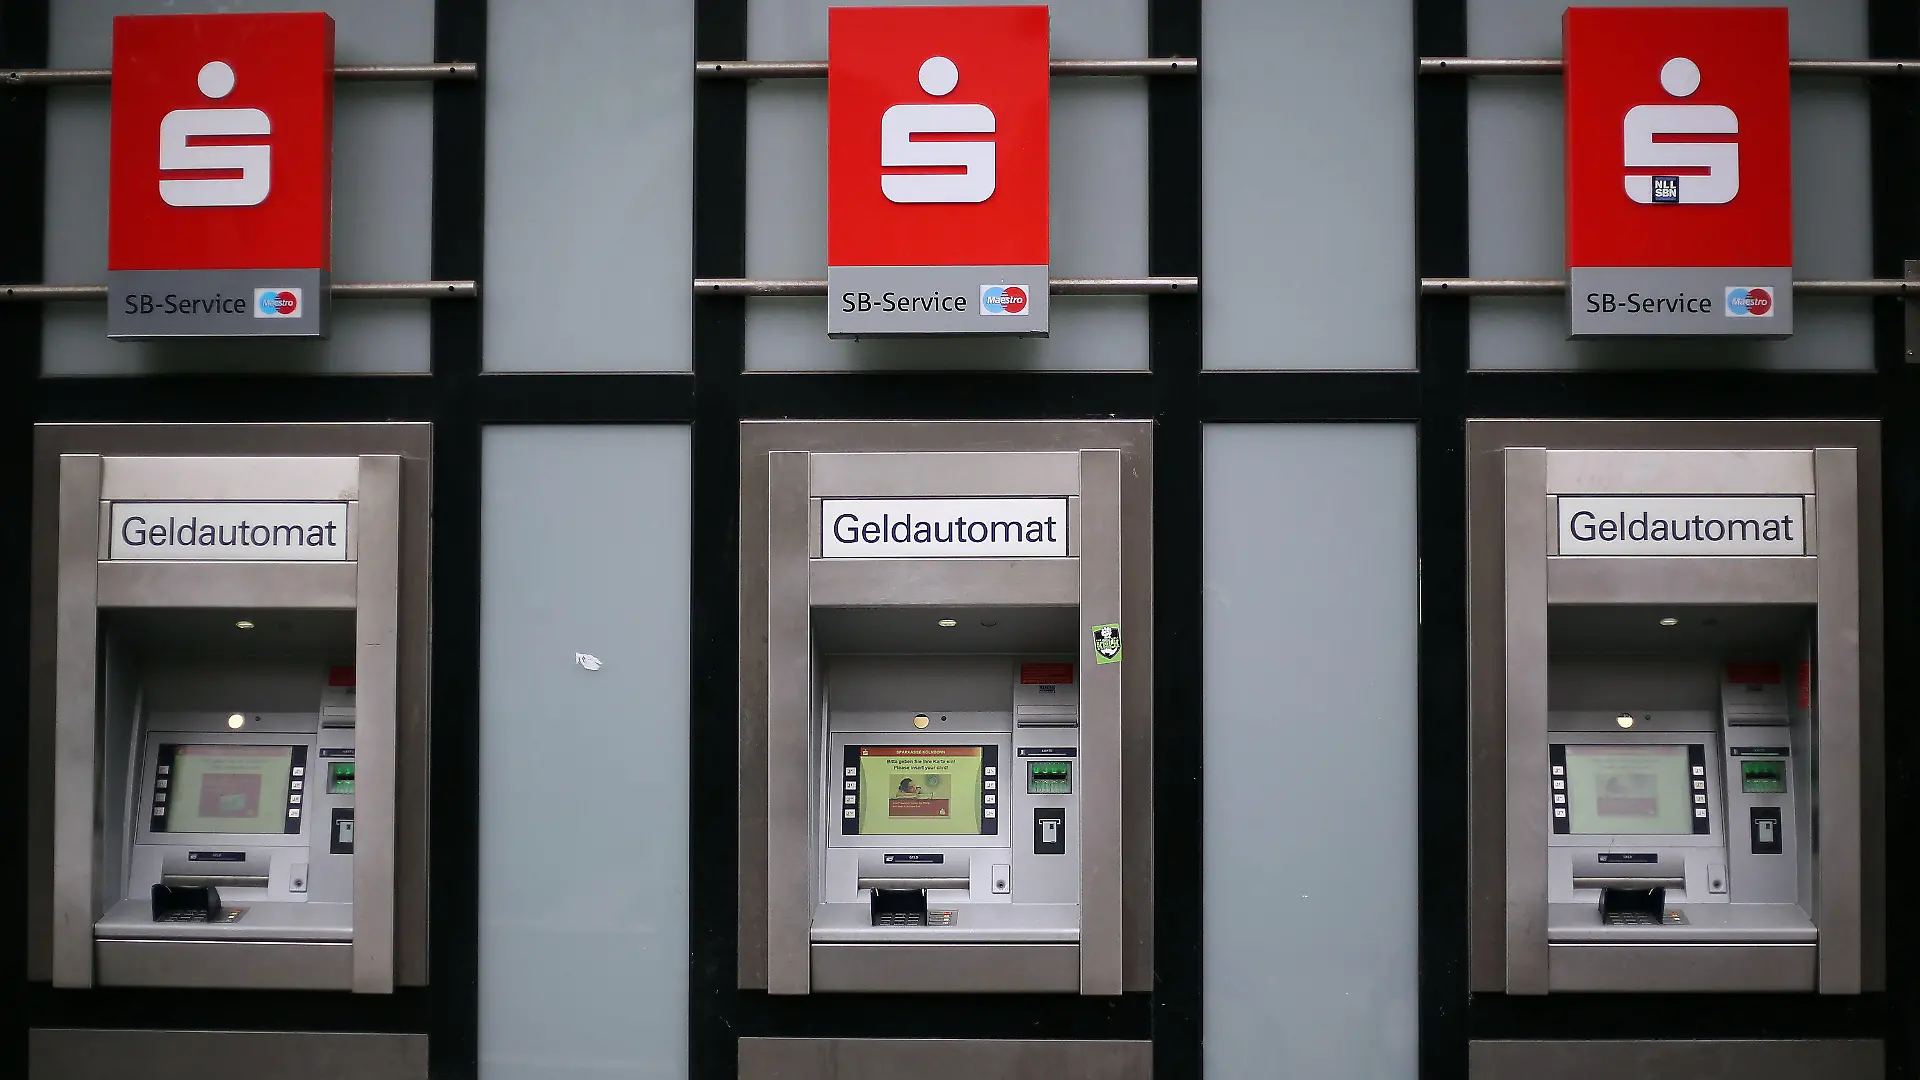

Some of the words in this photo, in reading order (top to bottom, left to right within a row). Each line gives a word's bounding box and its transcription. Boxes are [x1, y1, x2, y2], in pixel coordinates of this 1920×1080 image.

[1655, 180, 1676, 189] NLL
[1655, 188, 1677, 198] SBN
[125, 293, 246, 315] SB-Service
[262, 299, 294, 307] Maestro
[842, 291, 967, 313] SB-Service
[986, 295, 1023, 304] Maestro
[1587, 293, 1712, 314] SB-Service
[1731, 297, 1768, 306] Maestro
[121, 516, 337, 547] Geldautomat
[833, 513, 1057, 544] Geldautomat
[1570, 510, 1794, 542] Geldautomat
